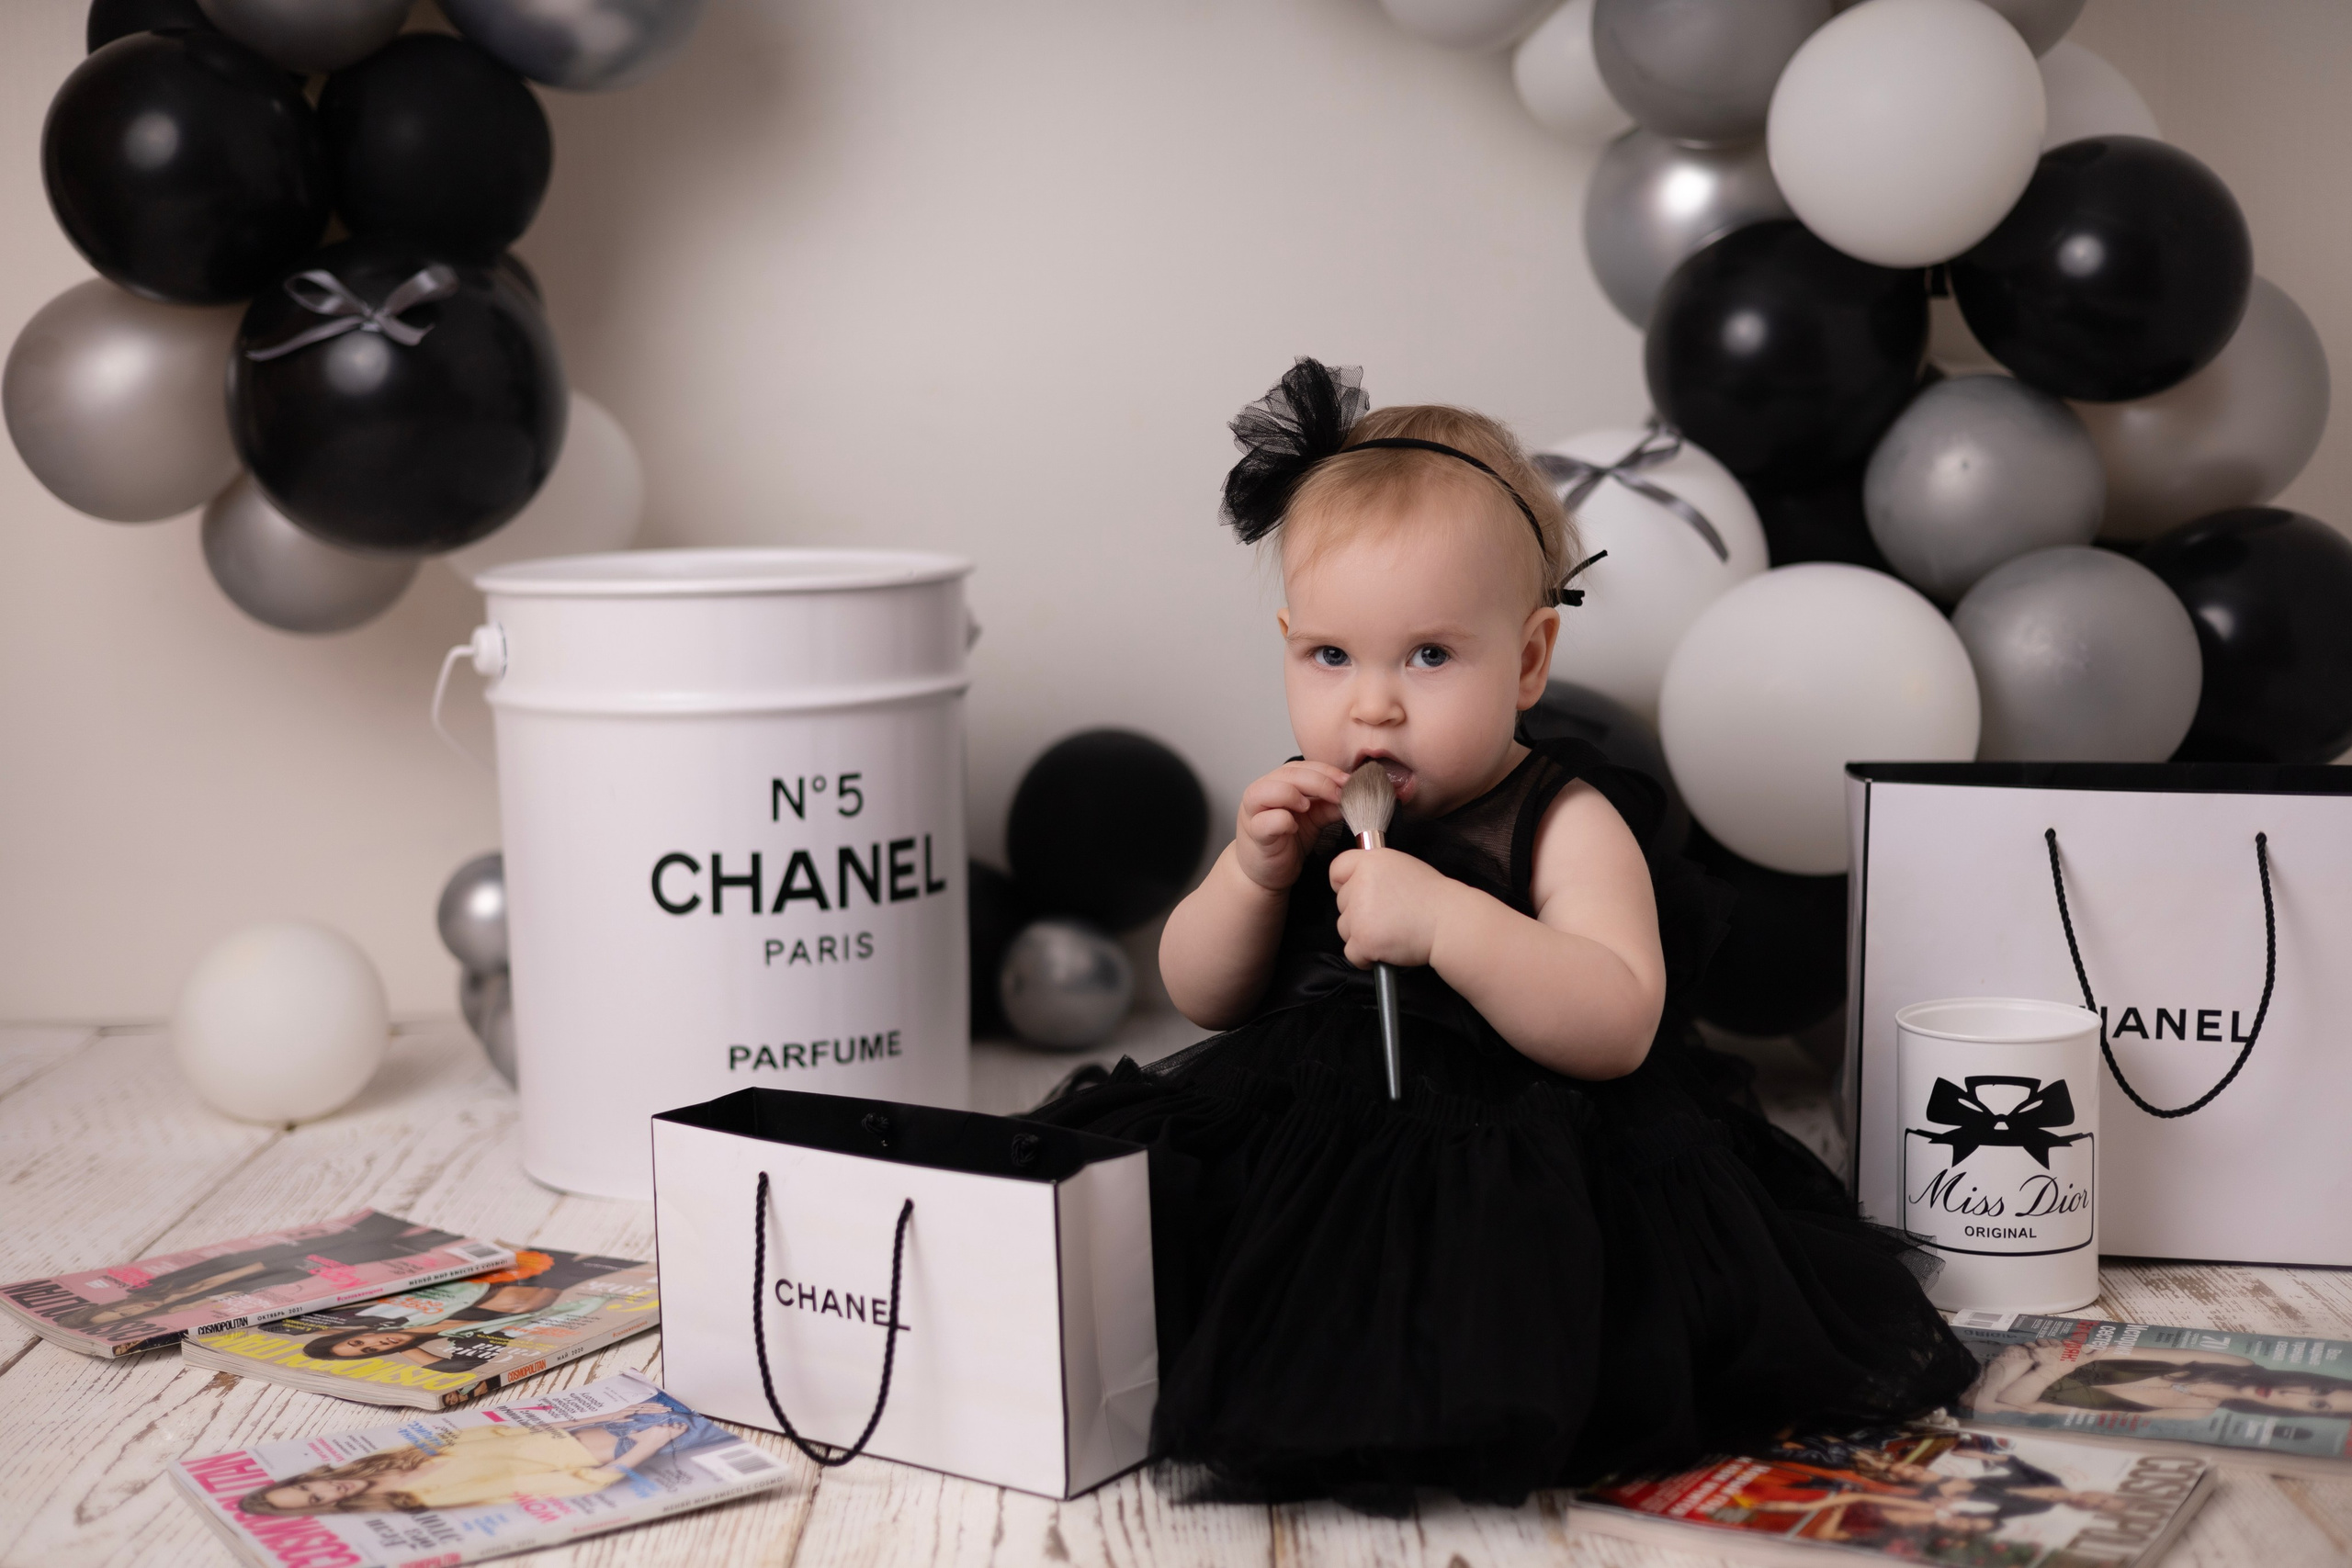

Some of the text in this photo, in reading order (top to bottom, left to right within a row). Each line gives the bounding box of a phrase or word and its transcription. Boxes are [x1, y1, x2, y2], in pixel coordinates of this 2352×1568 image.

[650, 833, 946, 916] CHANEL
[764, 931, 875, 965] PARIS
[728, 1030, 903, 1071] PARFUME
[1908, 1168, 2090, 1218] Miss Dior
[1963, 1224, 2038, 1239] ORIGINAL
[198, 1306, 303, 1336] COSMOPOLITAN ОКТЯБРЬ 2021
[2085, 1325, 2116, 1350] сестер
[2112, 1324, 2148, 1356] История
[2199, 1336, 2230, 1349] 70
[508, 1346, 583, 1382] COSMOPOLITAN МАЙ 2020
[662, 1500, 691, 1513] МЕНЯЙ
[694, 1495, 710, 1505] МИР
[715, 1485, 744, 1499] ВМЕСТЕ
[754, 1474, 786, 1489] COSMO!
